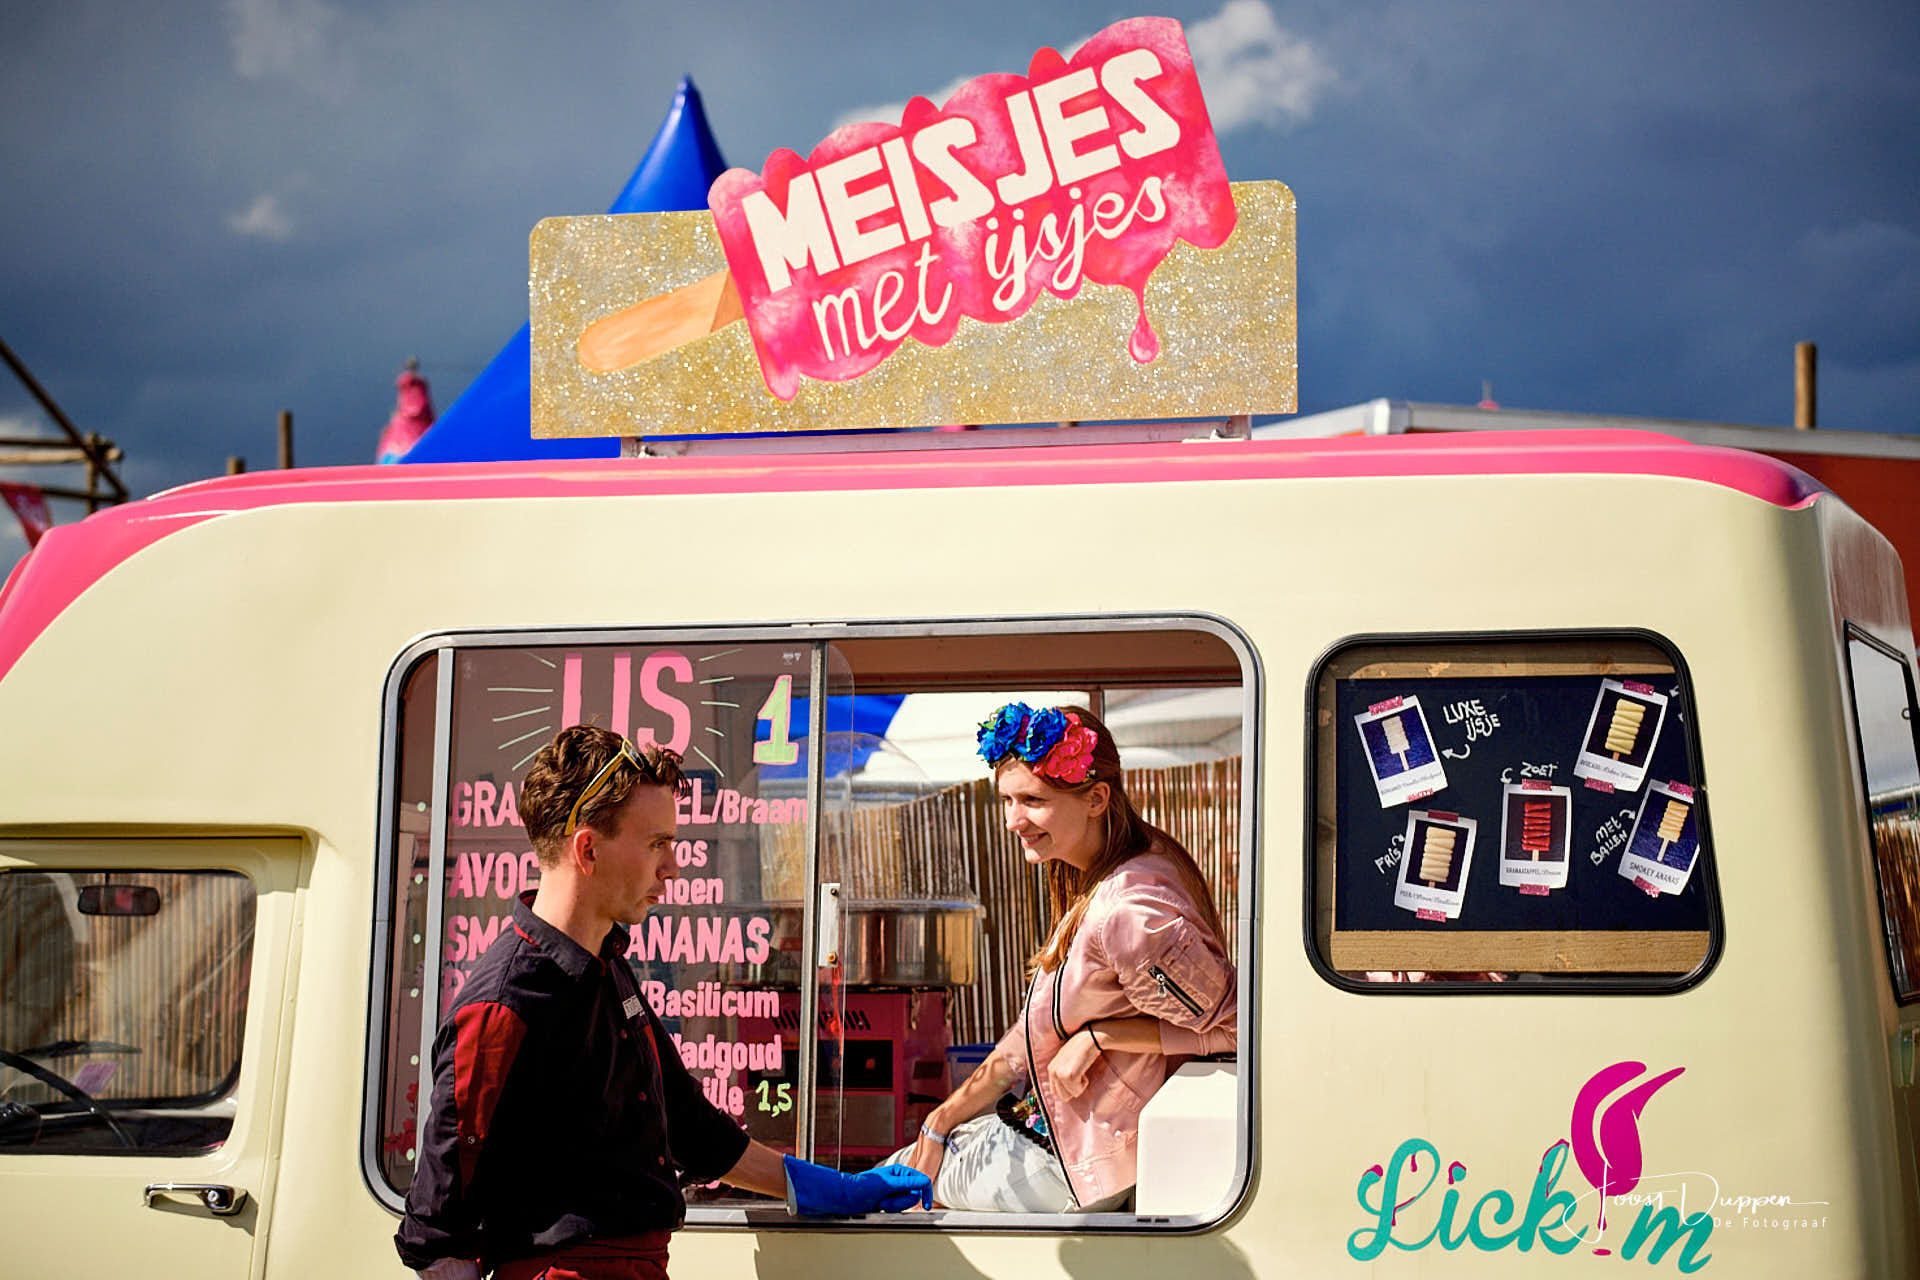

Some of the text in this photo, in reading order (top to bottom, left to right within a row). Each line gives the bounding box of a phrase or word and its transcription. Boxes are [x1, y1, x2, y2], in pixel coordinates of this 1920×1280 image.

[741, 48, 1181, 294] MEISJES
[812, 175, 1167, 362] met ijsjes
[753, 675, 799, 765] 1
[1443, 699, 1486, 724] LUXE
[1520, 761, 1559, 778] ZOET
[452, 777, 809, 828] GRA EL/Braam
[448, 851, 540, 899] AVOC
[624, 915, 771, 965] ANANAS
[702, 1077, 745, 1116] ille
[756, 1080, 793, 1117] 1,5
